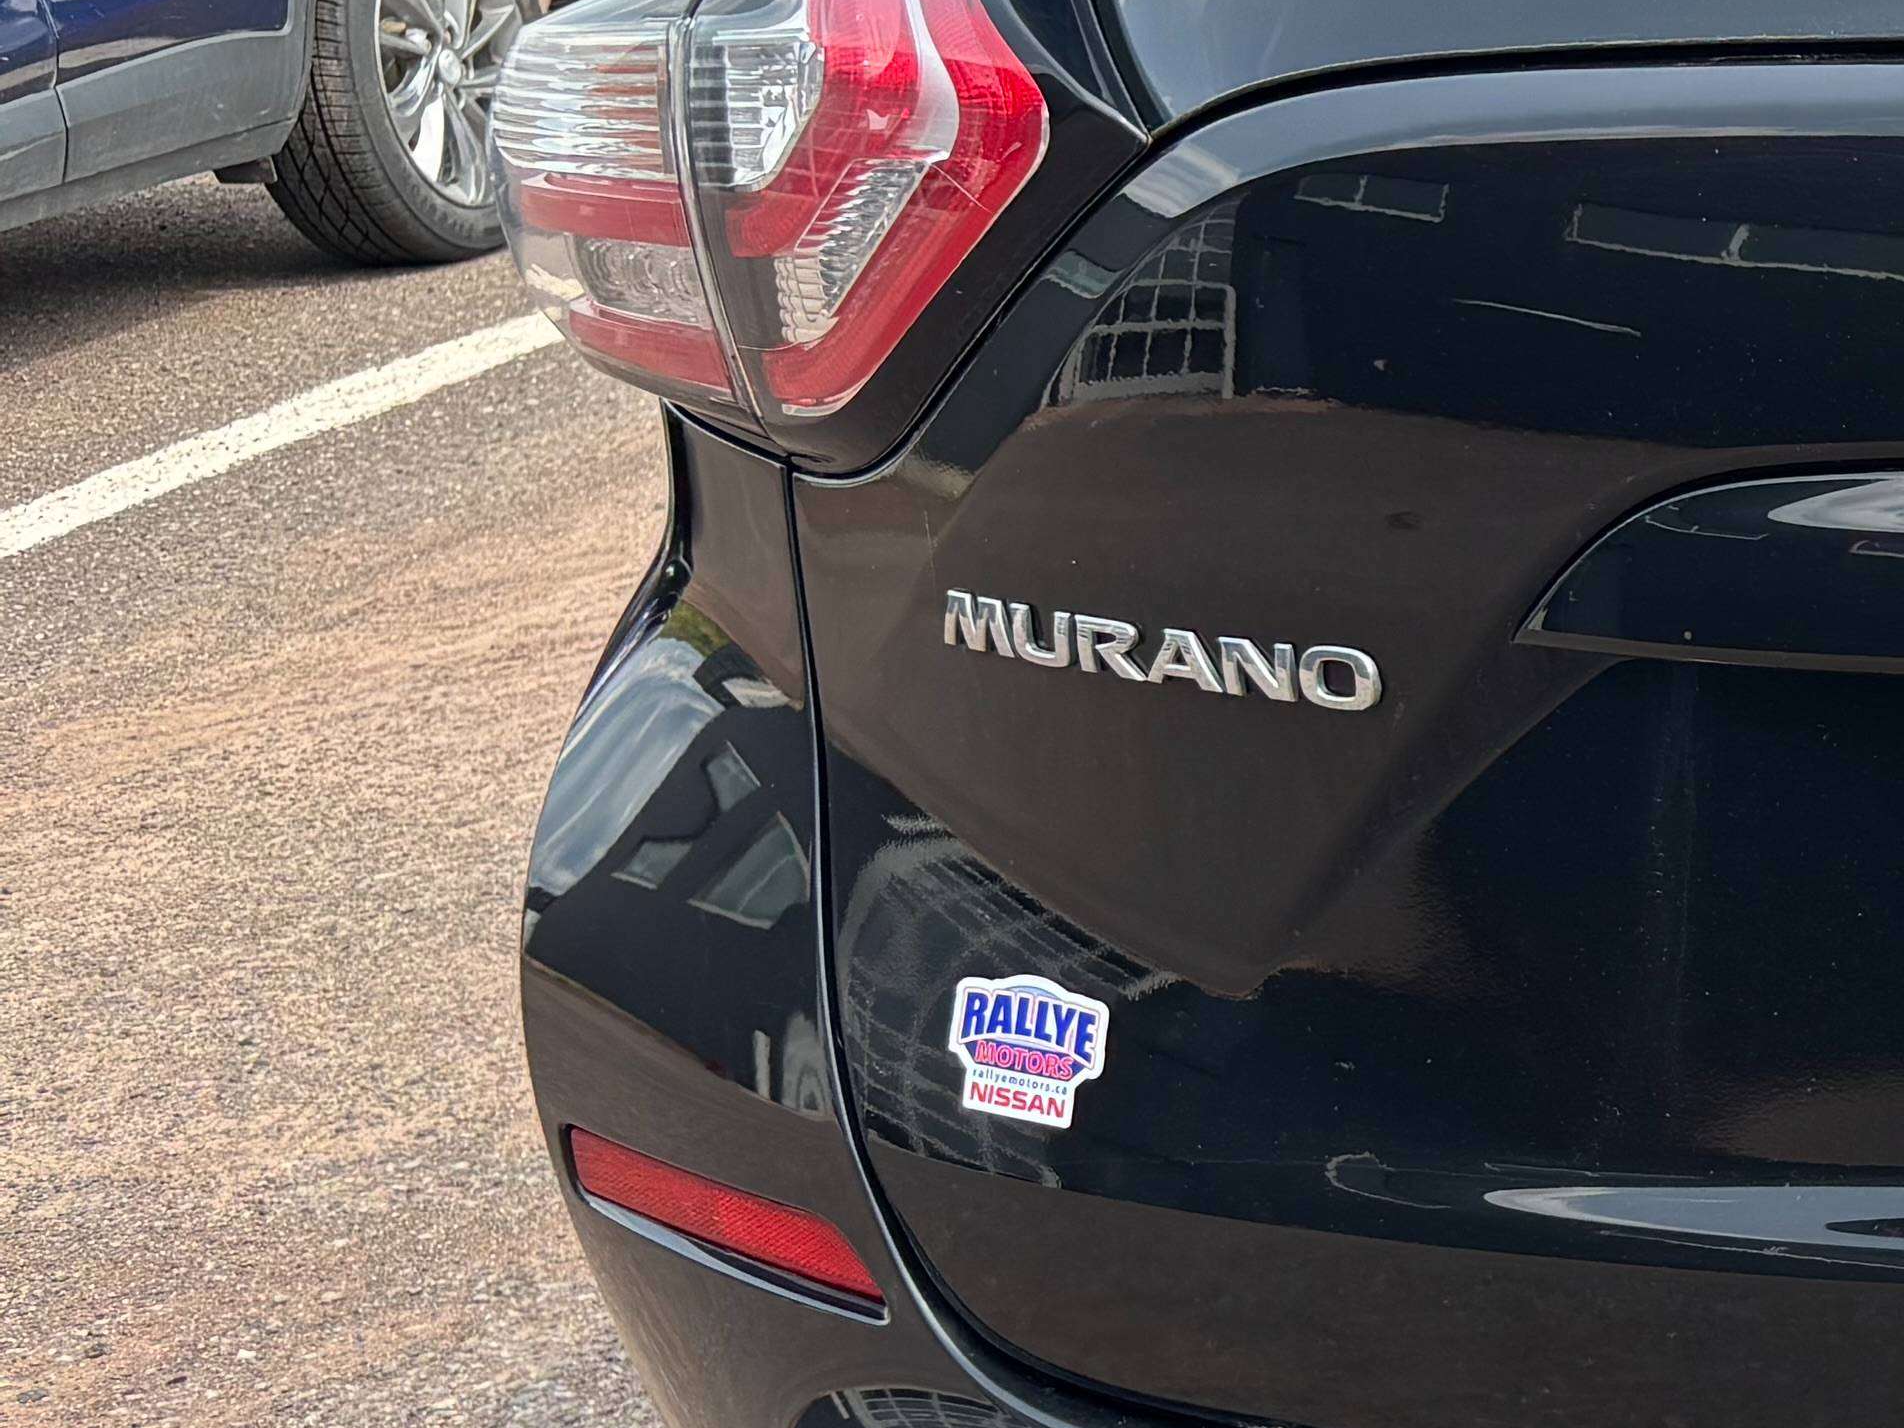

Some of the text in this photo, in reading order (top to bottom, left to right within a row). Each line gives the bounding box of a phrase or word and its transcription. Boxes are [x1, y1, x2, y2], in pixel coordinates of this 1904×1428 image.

[943, 587, 1383, 712] MURANO
[961, 991, 1097, 1062] RALLYE
[974, 1039, 1075, 1080] MOTORS
[969, 1081, 1066, 1119] NISSAN
